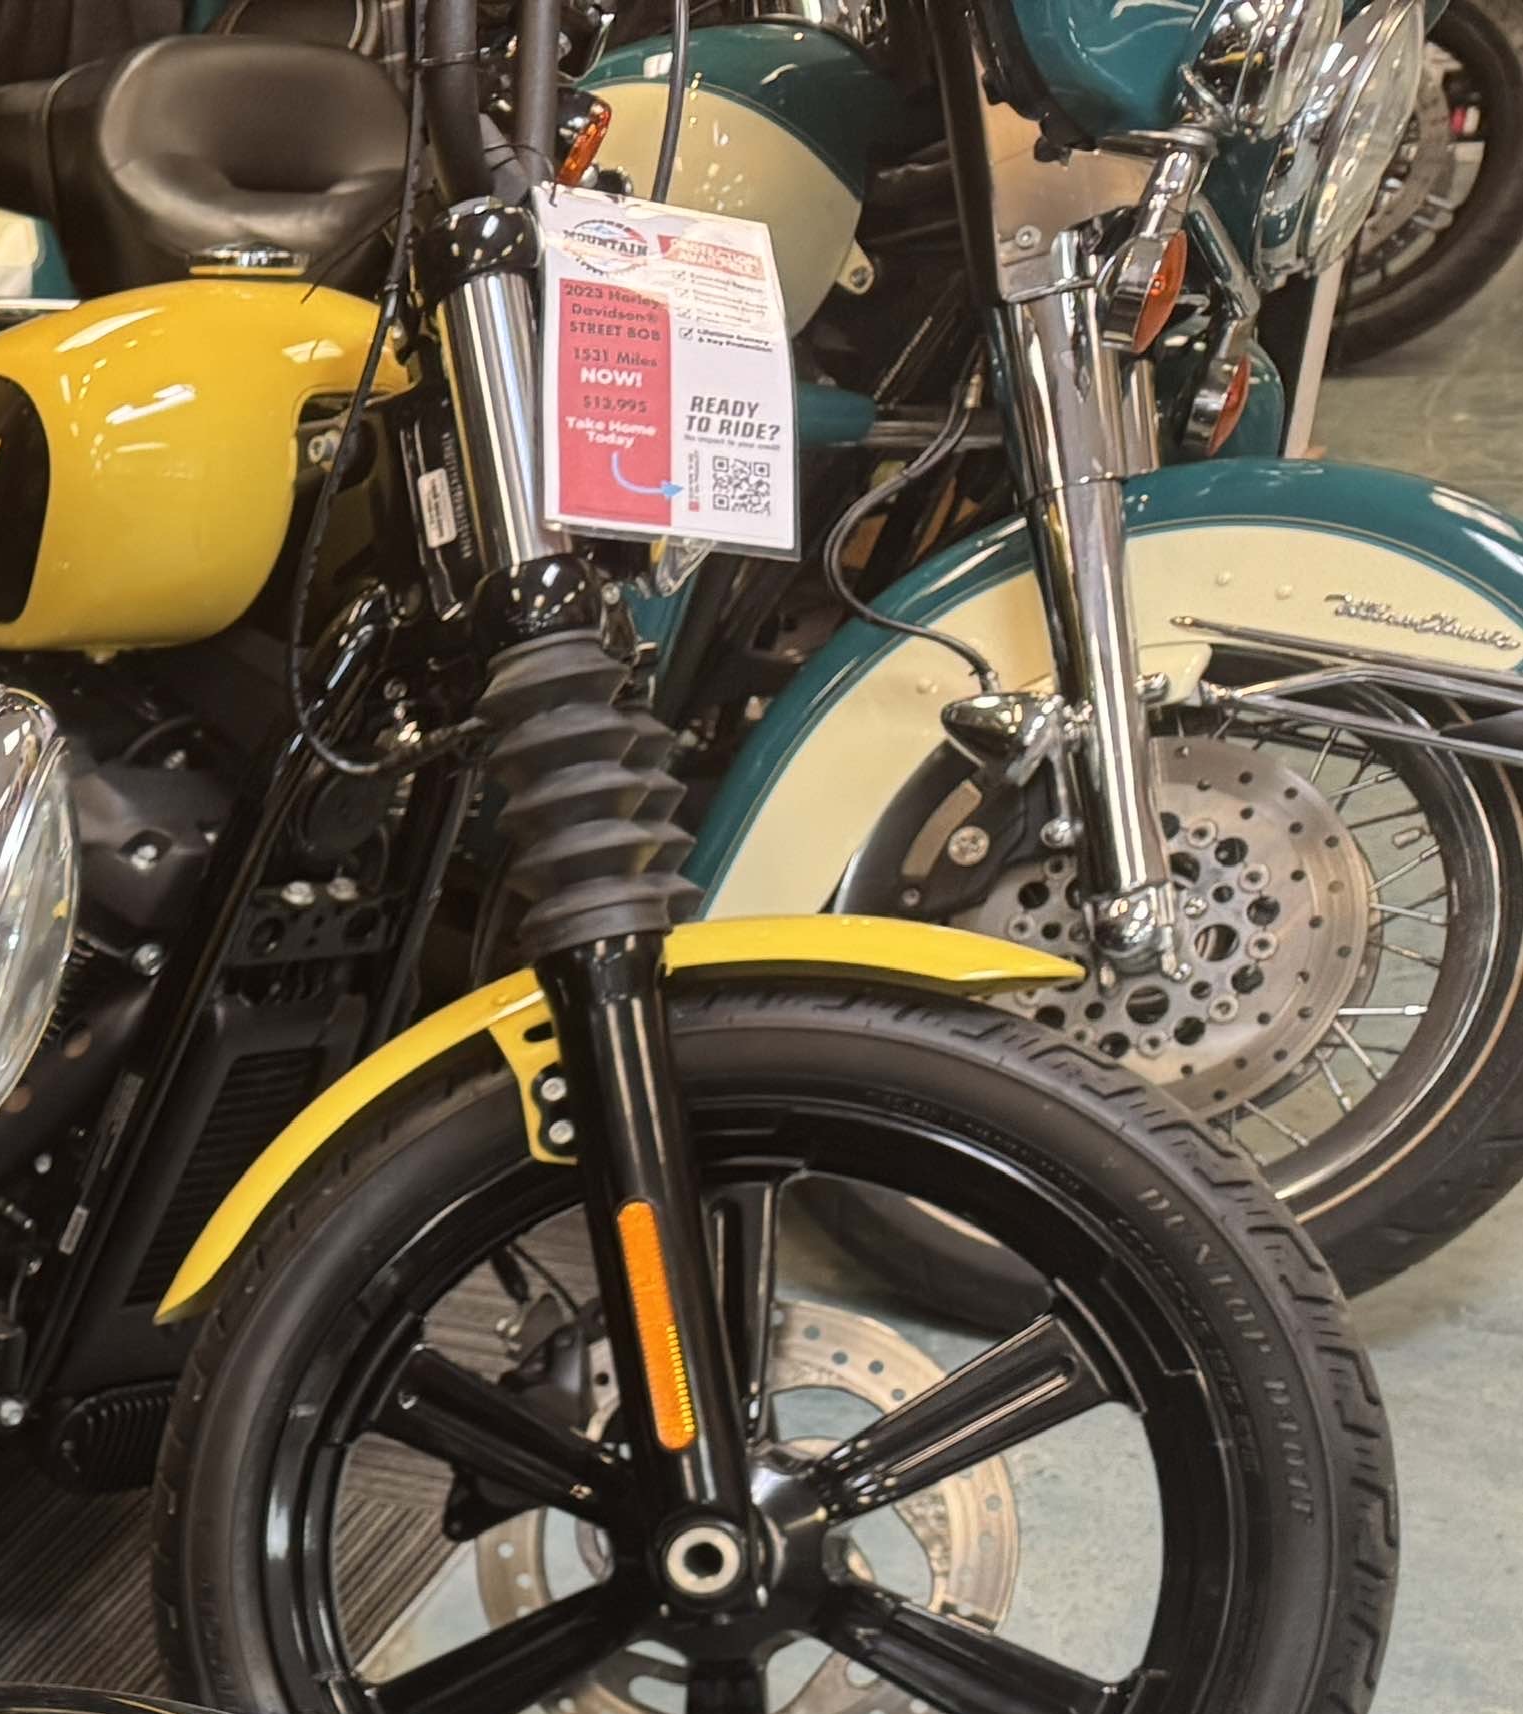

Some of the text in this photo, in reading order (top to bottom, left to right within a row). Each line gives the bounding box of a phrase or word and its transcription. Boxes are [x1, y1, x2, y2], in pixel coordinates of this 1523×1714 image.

[565, 283, 603, 300] 2023
[569, 317, 660, 341] STREET BOB
[580, 364, 642, 390] NOW!
[690, 393, 760, 420] READY
[566, 415, 656, 437] Take Home
[686, 414, 780, 443] TO RIDE?
[586, 429, 635, 448] Today
